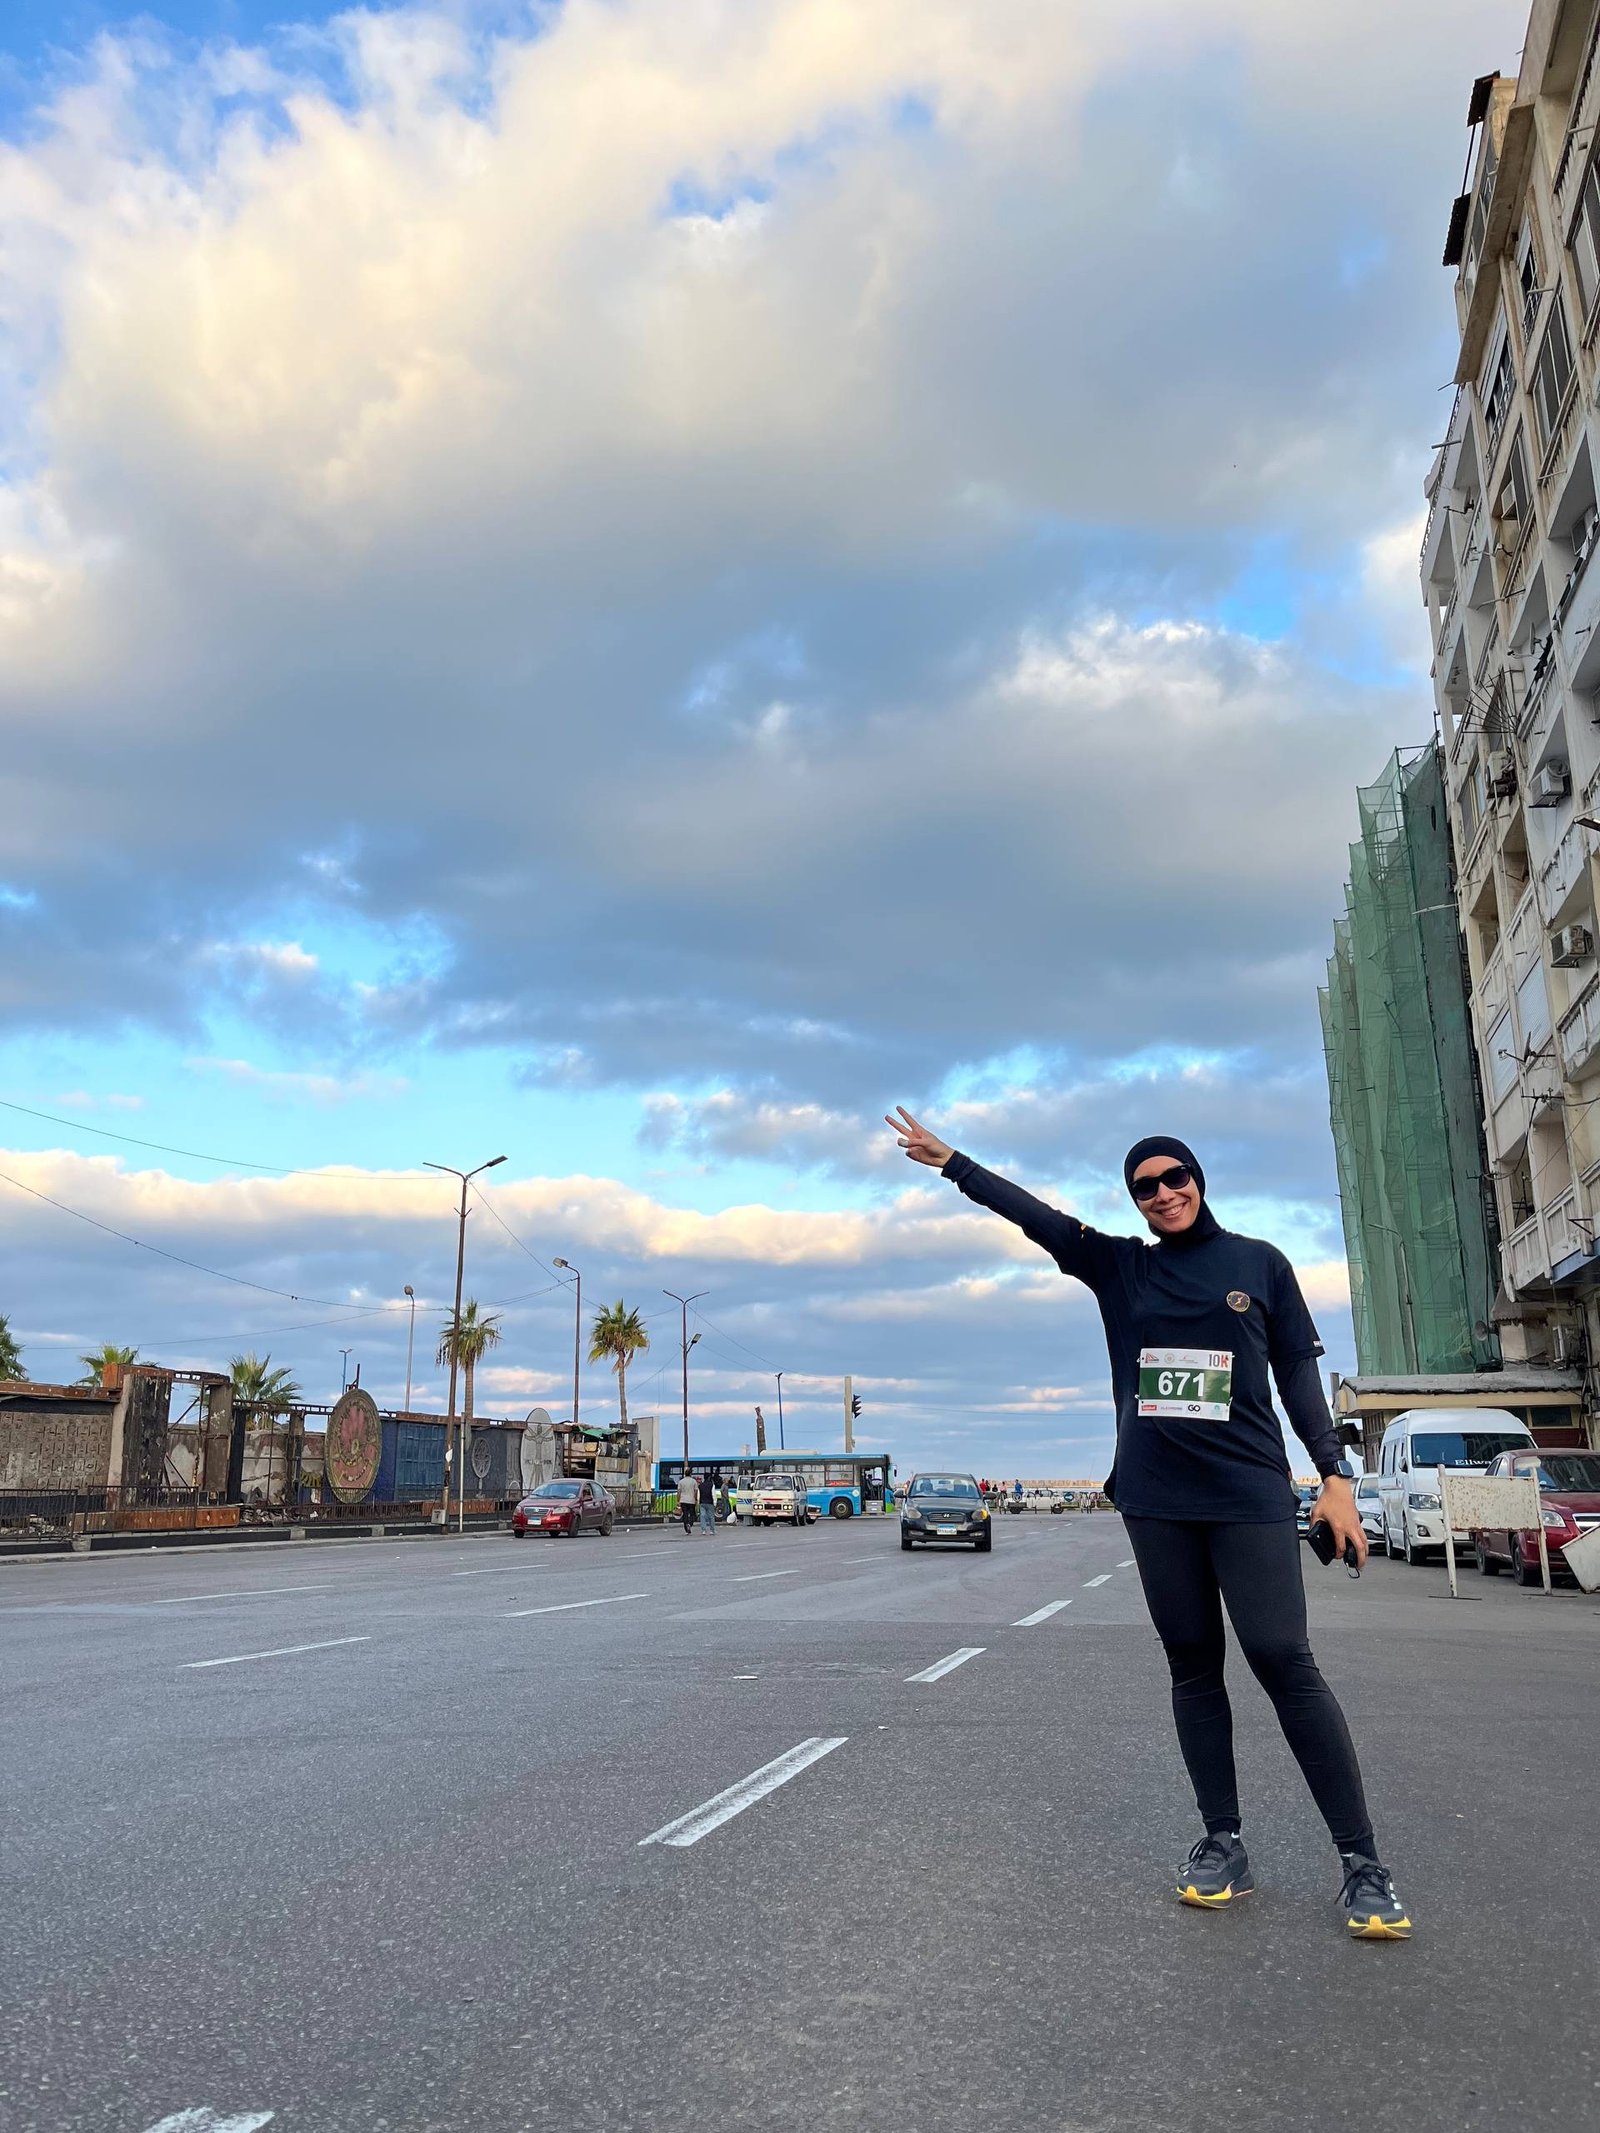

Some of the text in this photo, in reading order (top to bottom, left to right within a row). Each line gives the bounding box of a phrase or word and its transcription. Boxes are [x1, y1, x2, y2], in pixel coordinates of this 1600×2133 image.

[1209, 1353, 1229, 1368] 10K
[1158, 1371, 1205, 1397] 671
[1187, 1404, 1201, 1412] GO
